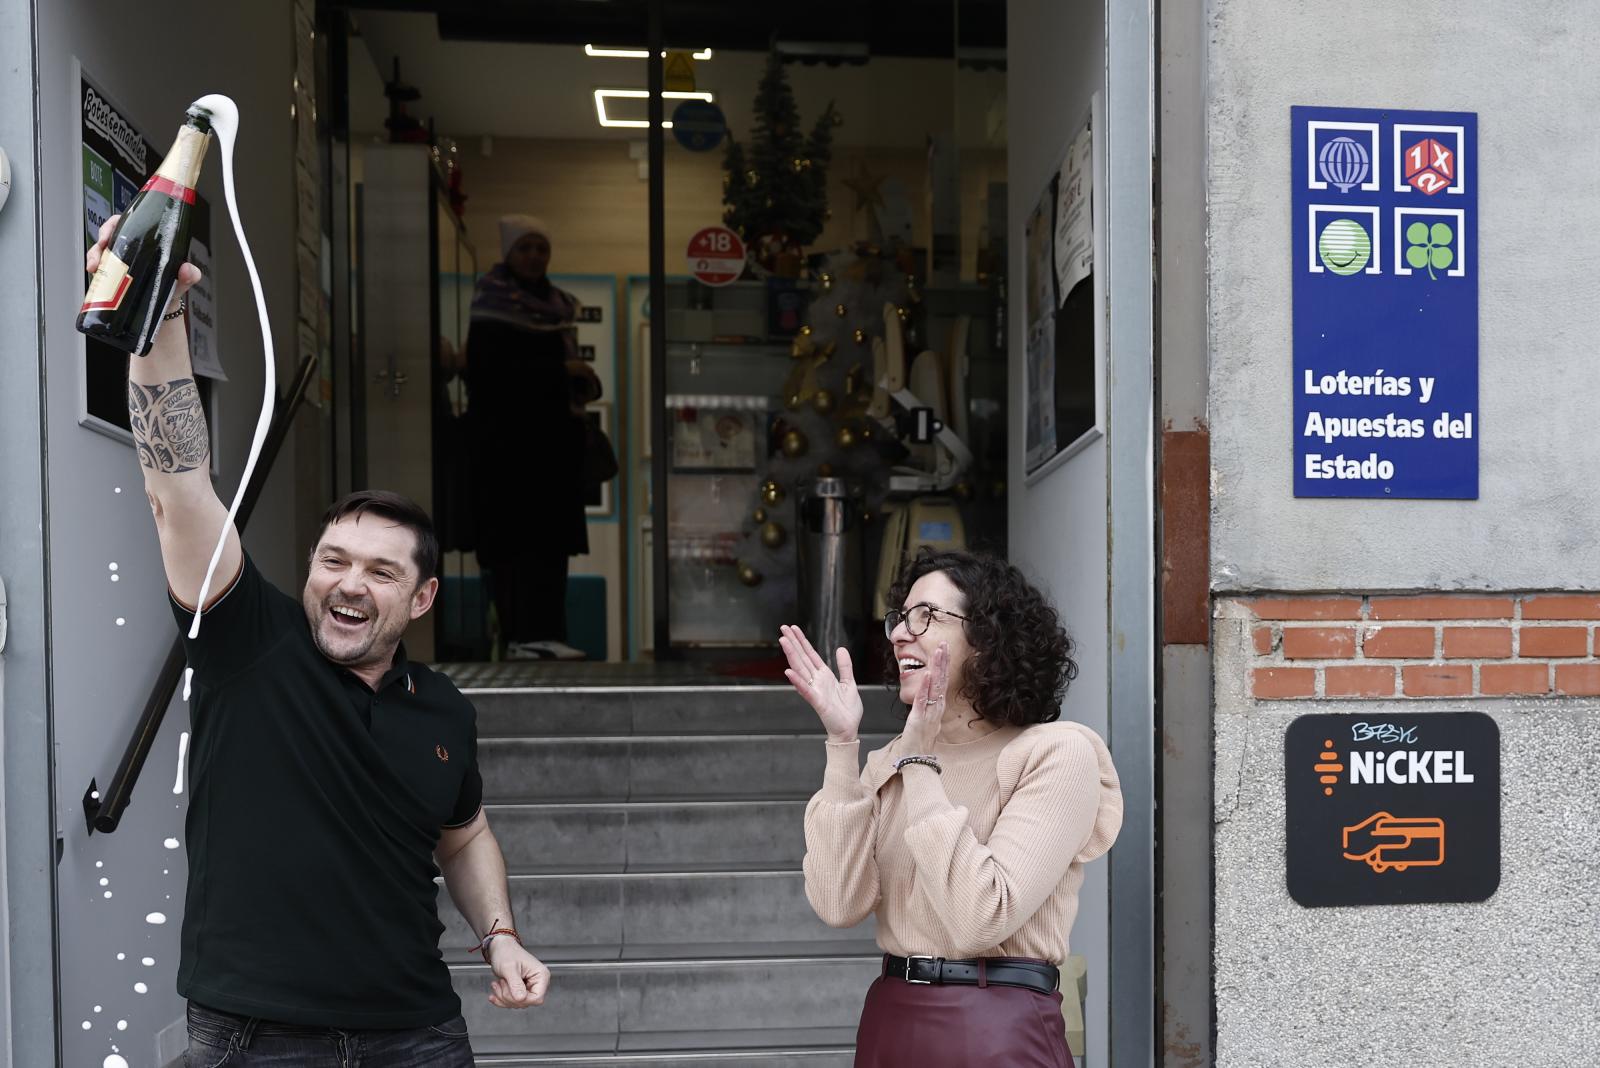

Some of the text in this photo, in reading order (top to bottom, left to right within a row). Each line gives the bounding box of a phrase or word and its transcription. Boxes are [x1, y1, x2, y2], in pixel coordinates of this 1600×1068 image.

[698, 232, 732, 252] +18
[1304, 368, 1435, 403] Loterías y
[1303, 411, 1472, 444] Apuestas del
[1305, 453, 1394, 480] Estado
[1350, 750, 1475, 785] NiCKEL
